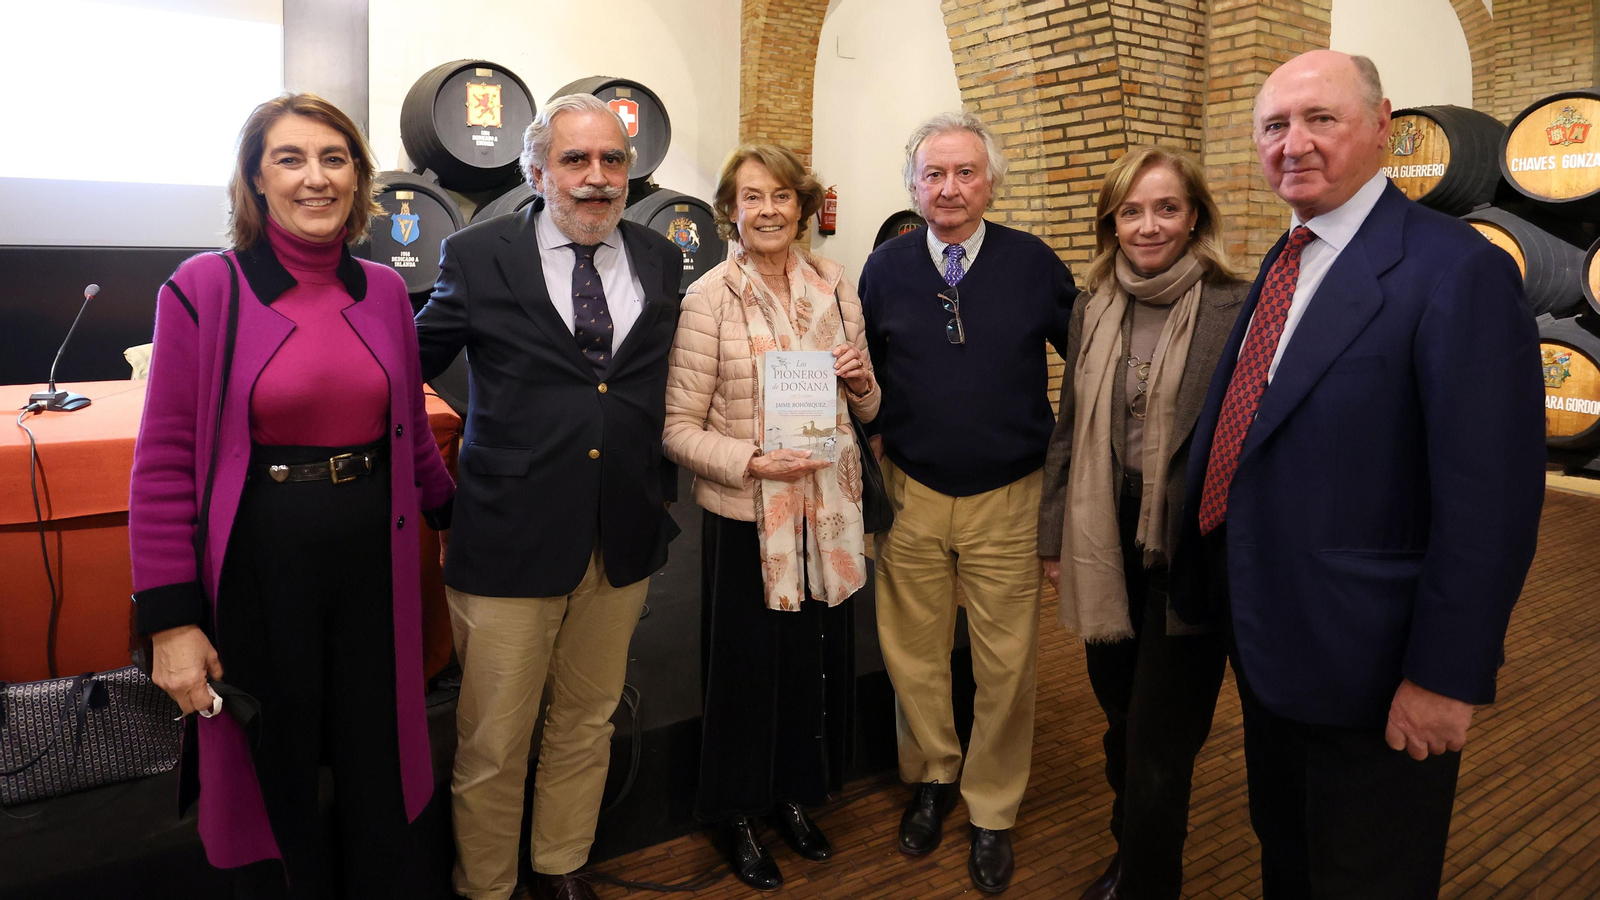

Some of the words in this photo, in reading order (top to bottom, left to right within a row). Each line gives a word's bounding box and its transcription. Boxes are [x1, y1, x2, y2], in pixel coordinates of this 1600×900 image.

[1511, 155, 1556, 172] CHAVES
[1381, 166, 1399, 178] RRA
[1400, 163, 1445, 178] GUERRERO
[796, 360, 807, 368] Los
[773, 369, 828, 379] PIONEROS
[780, 380, 830, 392] DOÑANA
[792, 401, 827, 409] BOHÓRQUEZ
[1545, 395, 1564, 411] ARA
